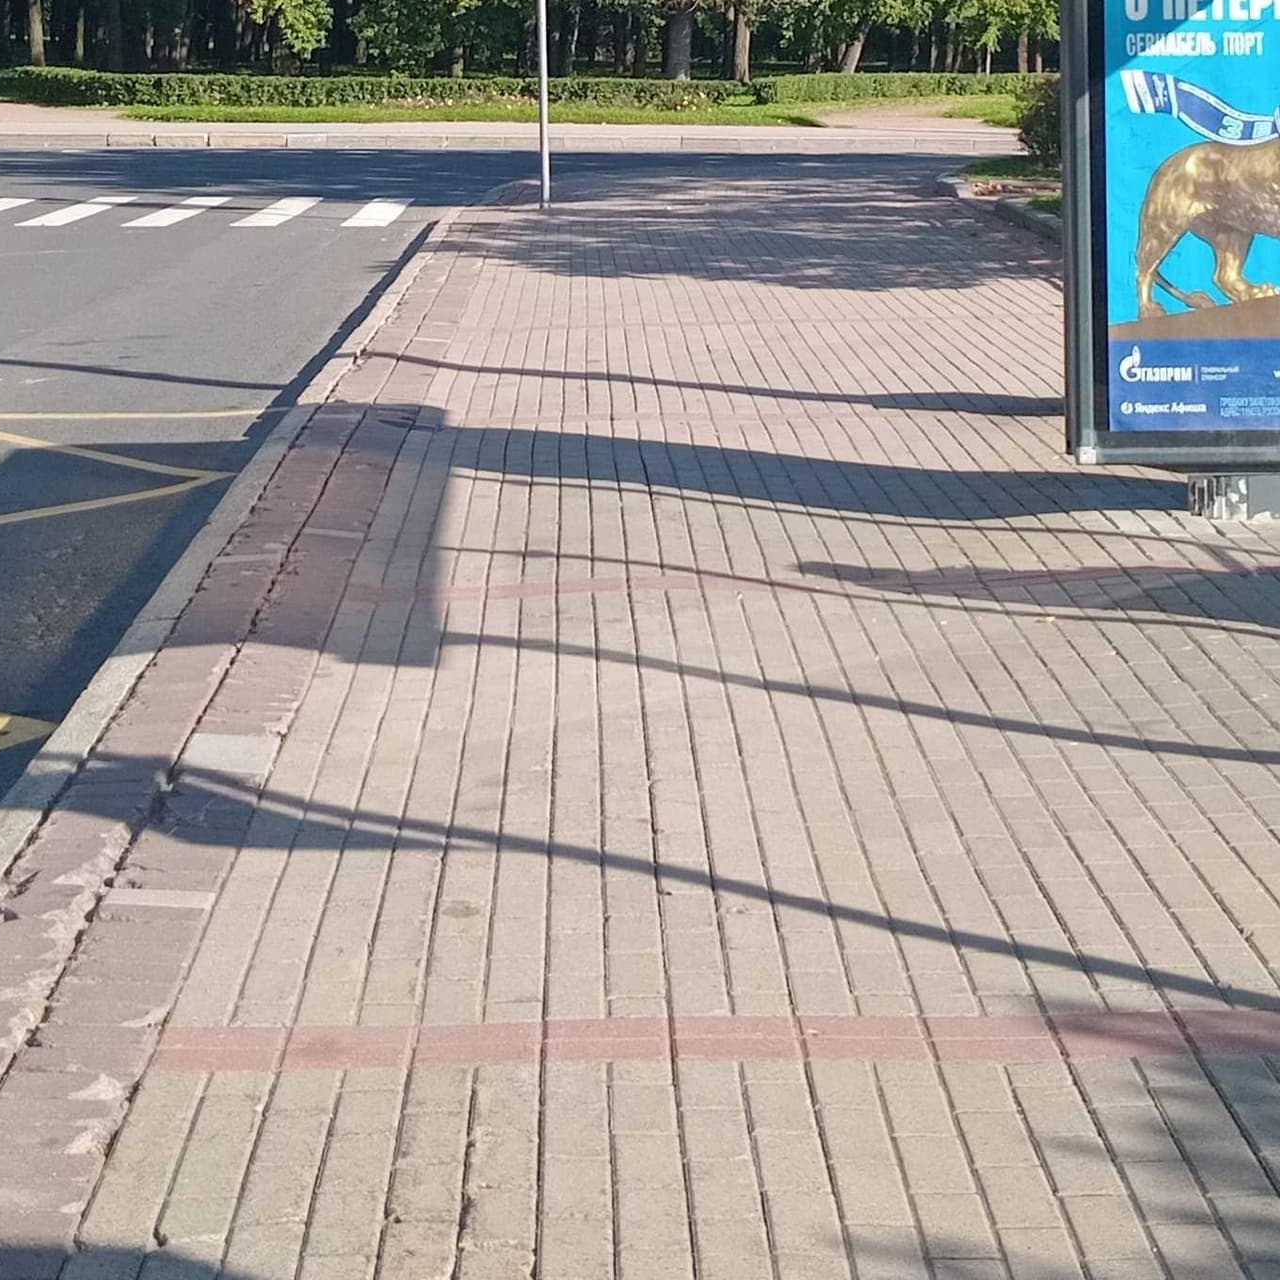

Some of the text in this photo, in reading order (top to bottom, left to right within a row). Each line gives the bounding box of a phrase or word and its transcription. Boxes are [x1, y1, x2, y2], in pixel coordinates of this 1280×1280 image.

[1222, 31, 1264, 56] ПОРТ
[1140, 367, 1193, 382] ГАЗПРОМ
[1135, 402, 1170, 414] Яндекс
[1170, 402, 1207, 414] Афиша
